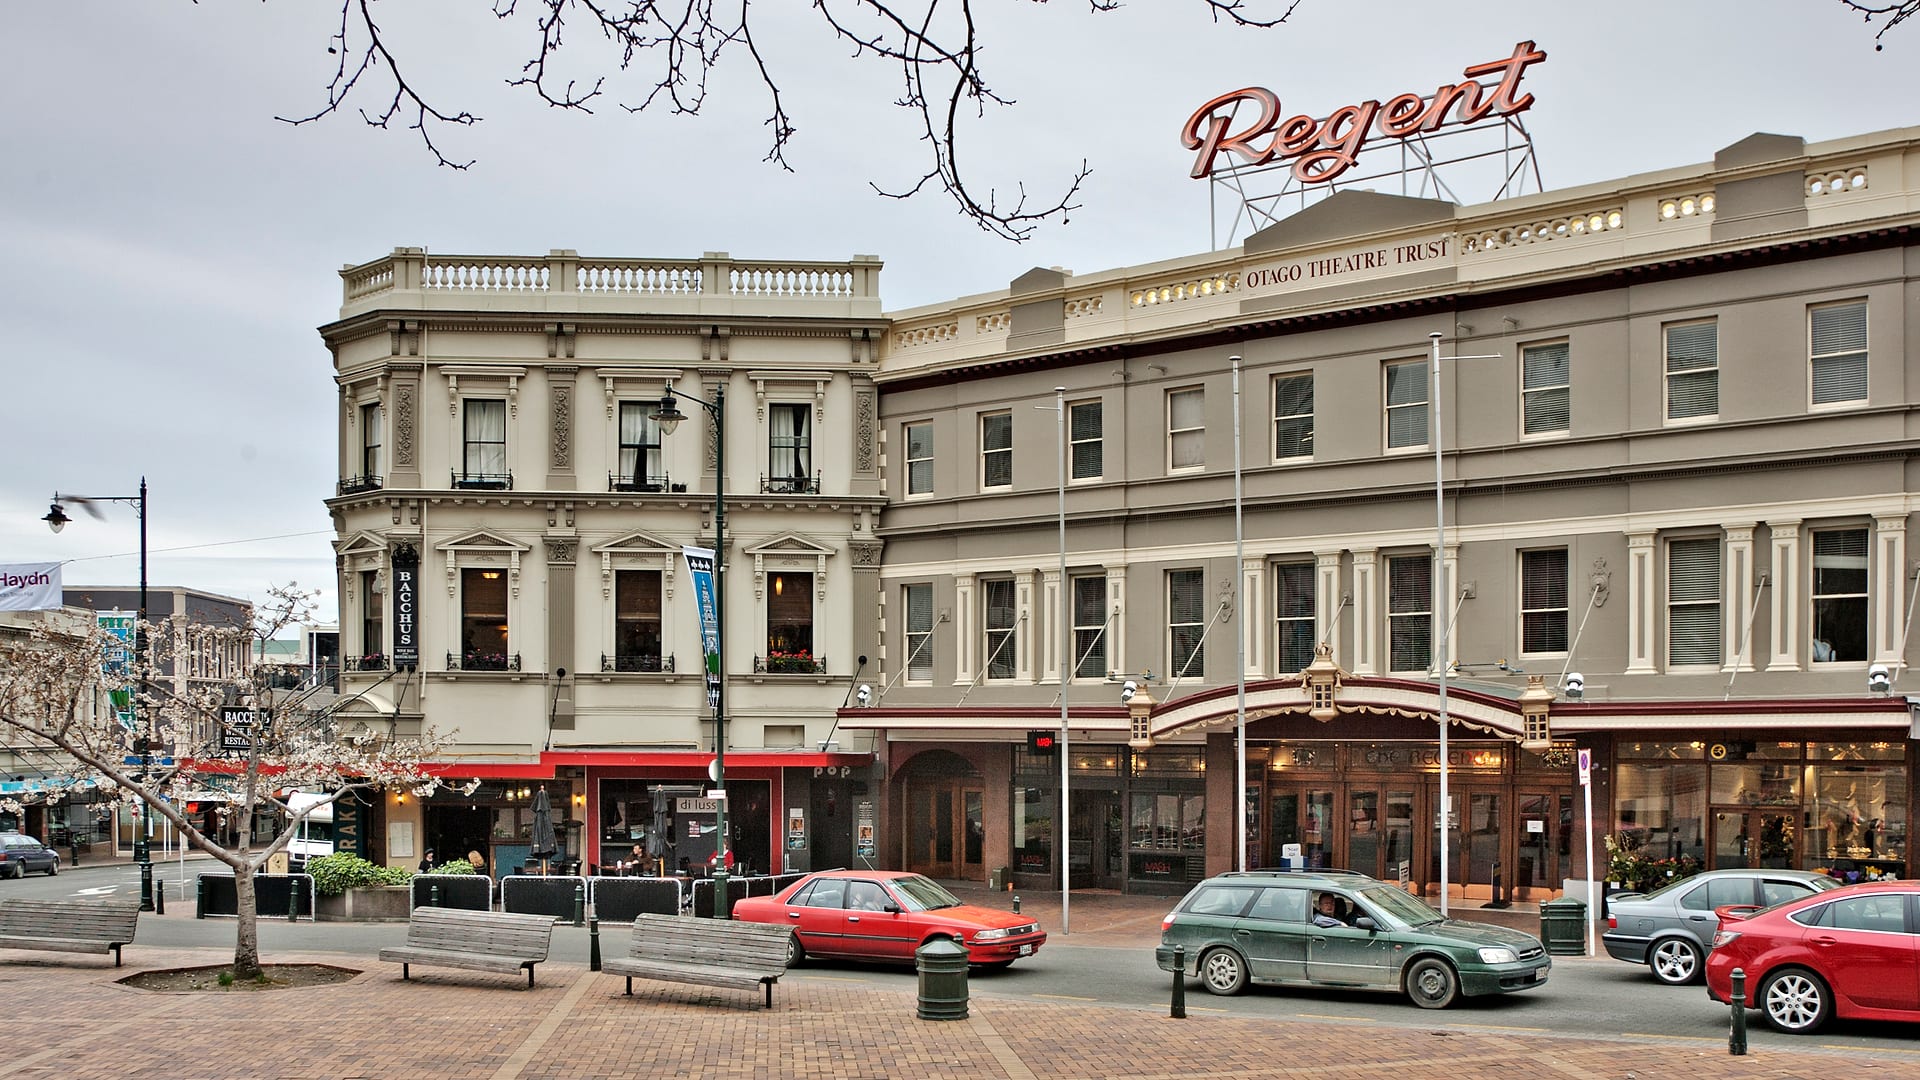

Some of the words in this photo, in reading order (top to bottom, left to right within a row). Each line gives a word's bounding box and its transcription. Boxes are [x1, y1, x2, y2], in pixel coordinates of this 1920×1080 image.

[1181, 40, 1547, 184] Regent
[1247, 264, 1302, 288] OTAGO
[1307, 249, 1387, 278] THEATRE
[1394, 240, 1449, 263] TRUST
[399, 571, 412, 644] BACCHUS
[813, 766, 850, 778] pop
[680, 799, 691, 809] di
[695, 799, 717, 809] luss
